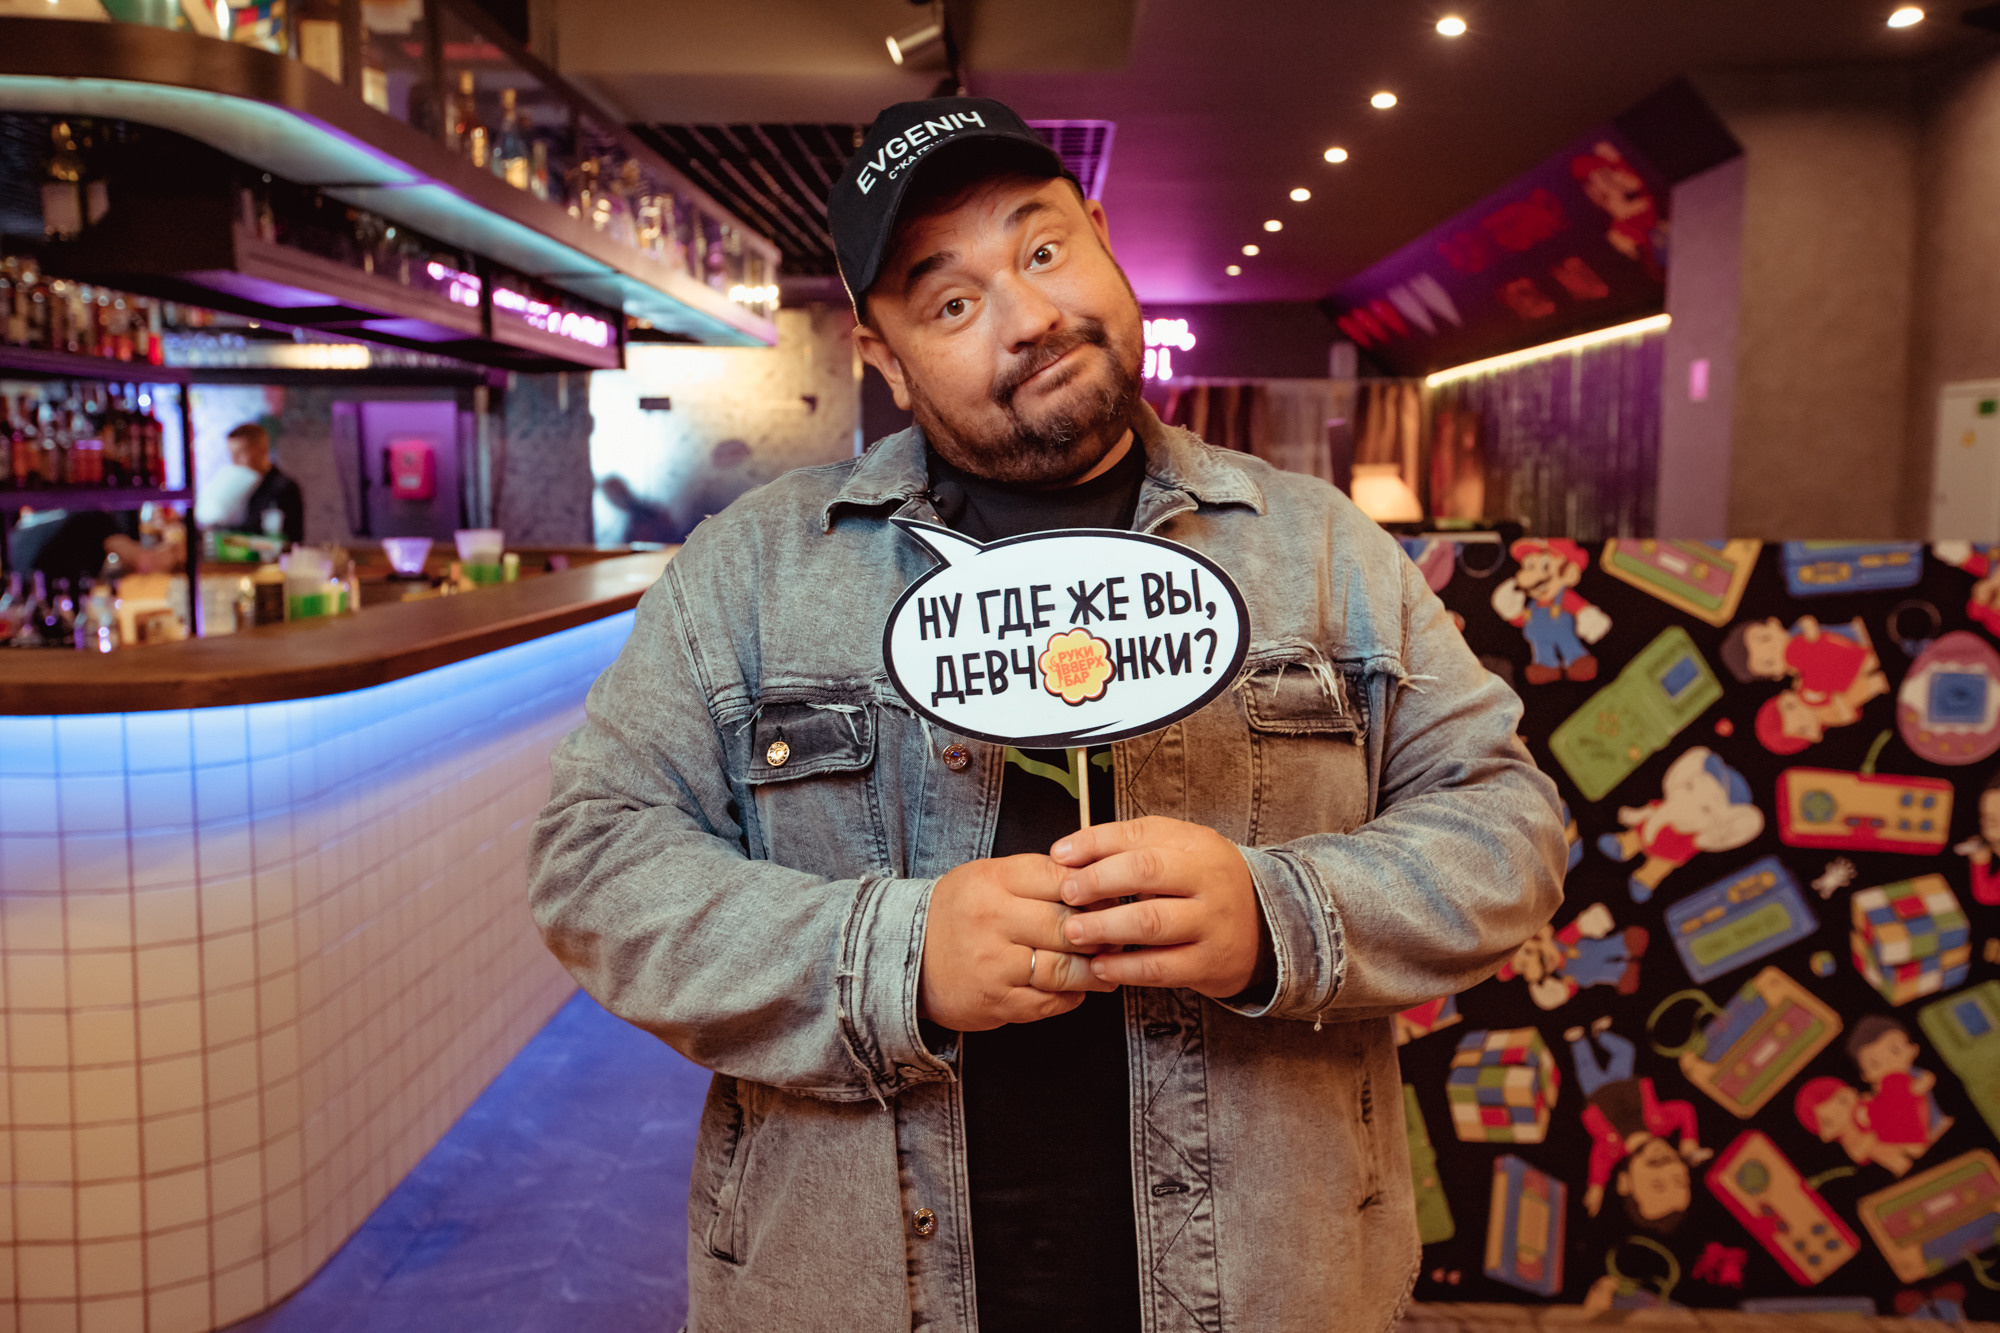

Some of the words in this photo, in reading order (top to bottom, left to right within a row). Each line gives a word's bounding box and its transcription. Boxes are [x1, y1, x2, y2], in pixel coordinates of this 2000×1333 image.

[917, 595, 963, 641] НУ
[977, 584, 1056, 640] ГДЕ
[1066, 576, 1129, 626] ЖЕ
[1140, 568, 1217, 621] ВЫ,
[1057, 645, 1095, 663] РУКИ
[1060, 655, 1105, 675] ВВЕРХ
[1063, 671, 1090, 687] БАР
